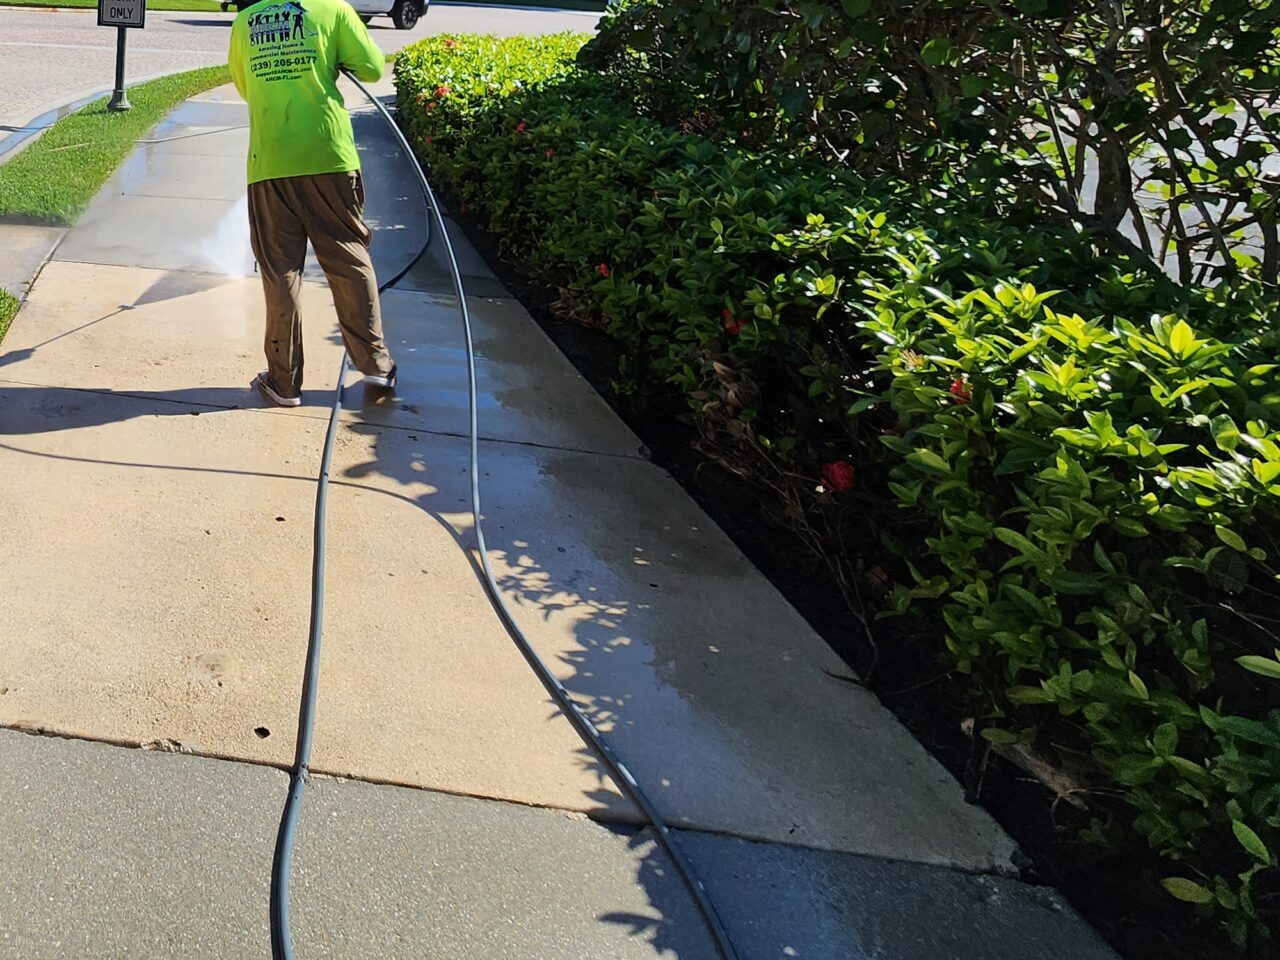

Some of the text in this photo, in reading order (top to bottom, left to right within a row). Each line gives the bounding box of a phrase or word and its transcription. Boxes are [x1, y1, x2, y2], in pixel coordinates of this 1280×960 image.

[109, 6, 134, 20] ONLY
[250, 56, 317, 74] (239) 205-0177
